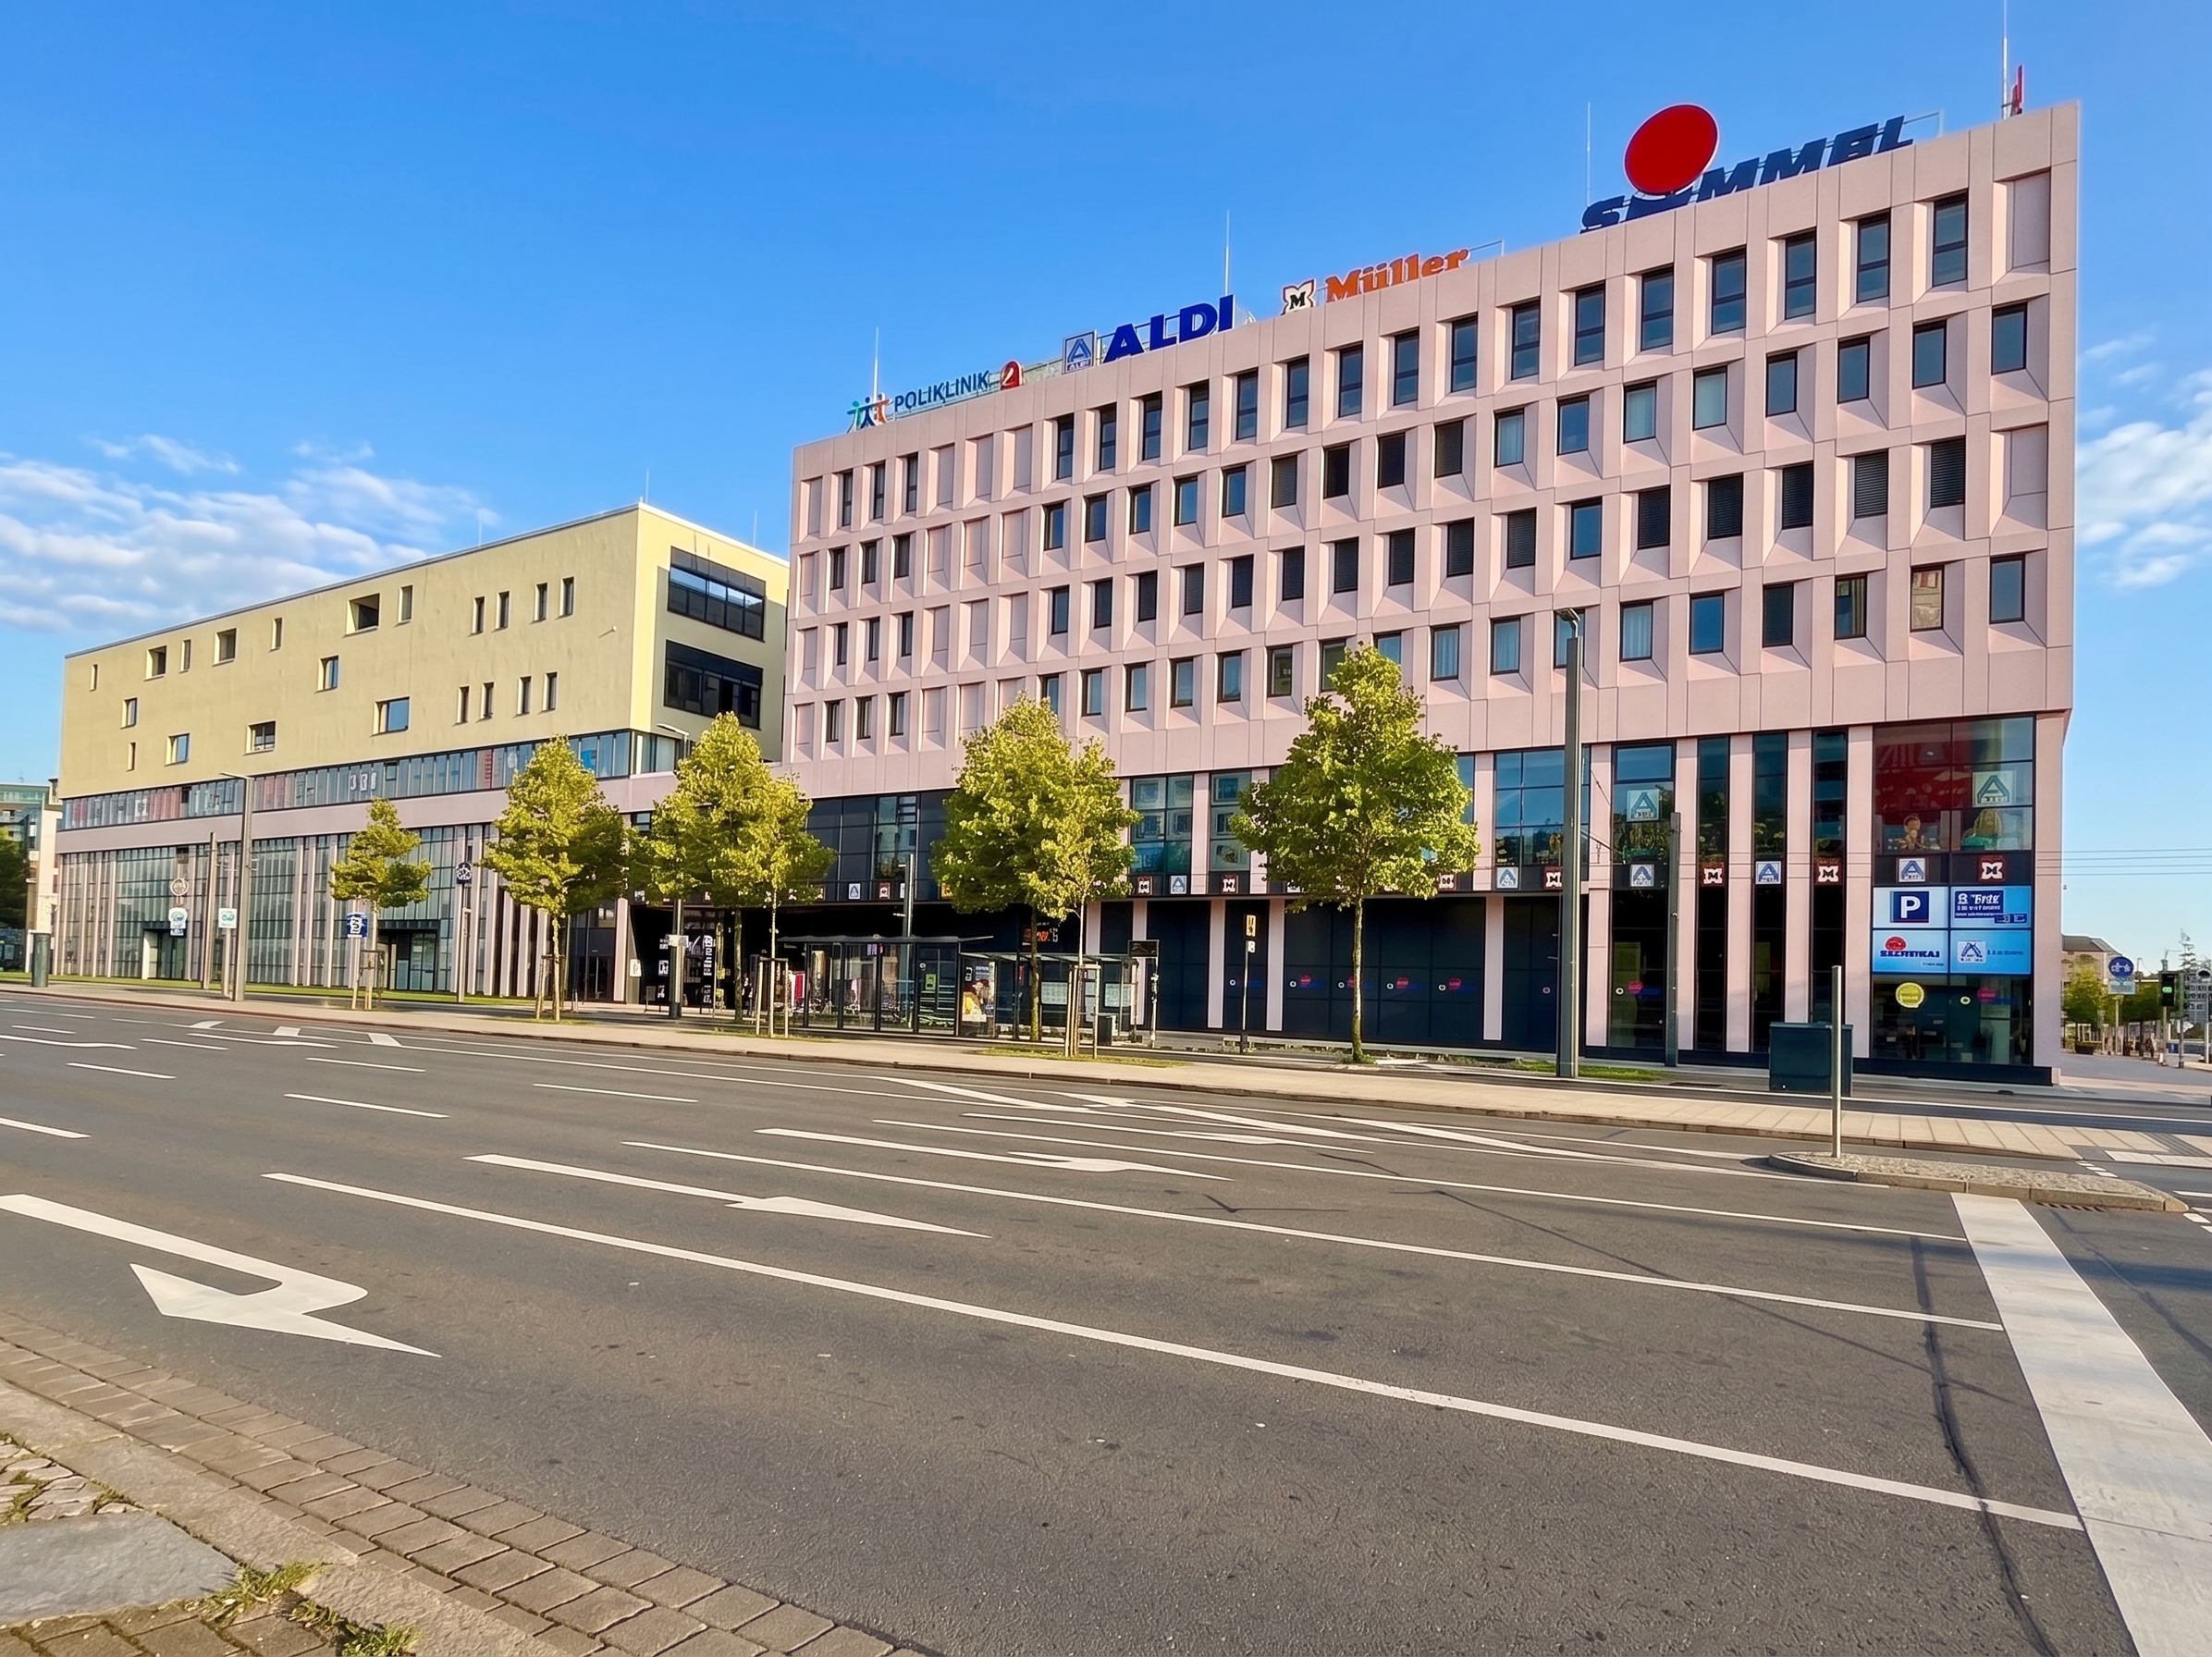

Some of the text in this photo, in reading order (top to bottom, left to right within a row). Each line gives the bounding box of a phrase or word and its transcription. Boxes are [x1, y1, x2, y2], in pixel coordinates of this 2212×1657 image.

[1325, 247, 1470, 303] Müller
[1103, 294, 1235, 363] ALDI
[894, 371, 989, 412] POLIKLINIK
[1900, 895, 1922, 919] P
